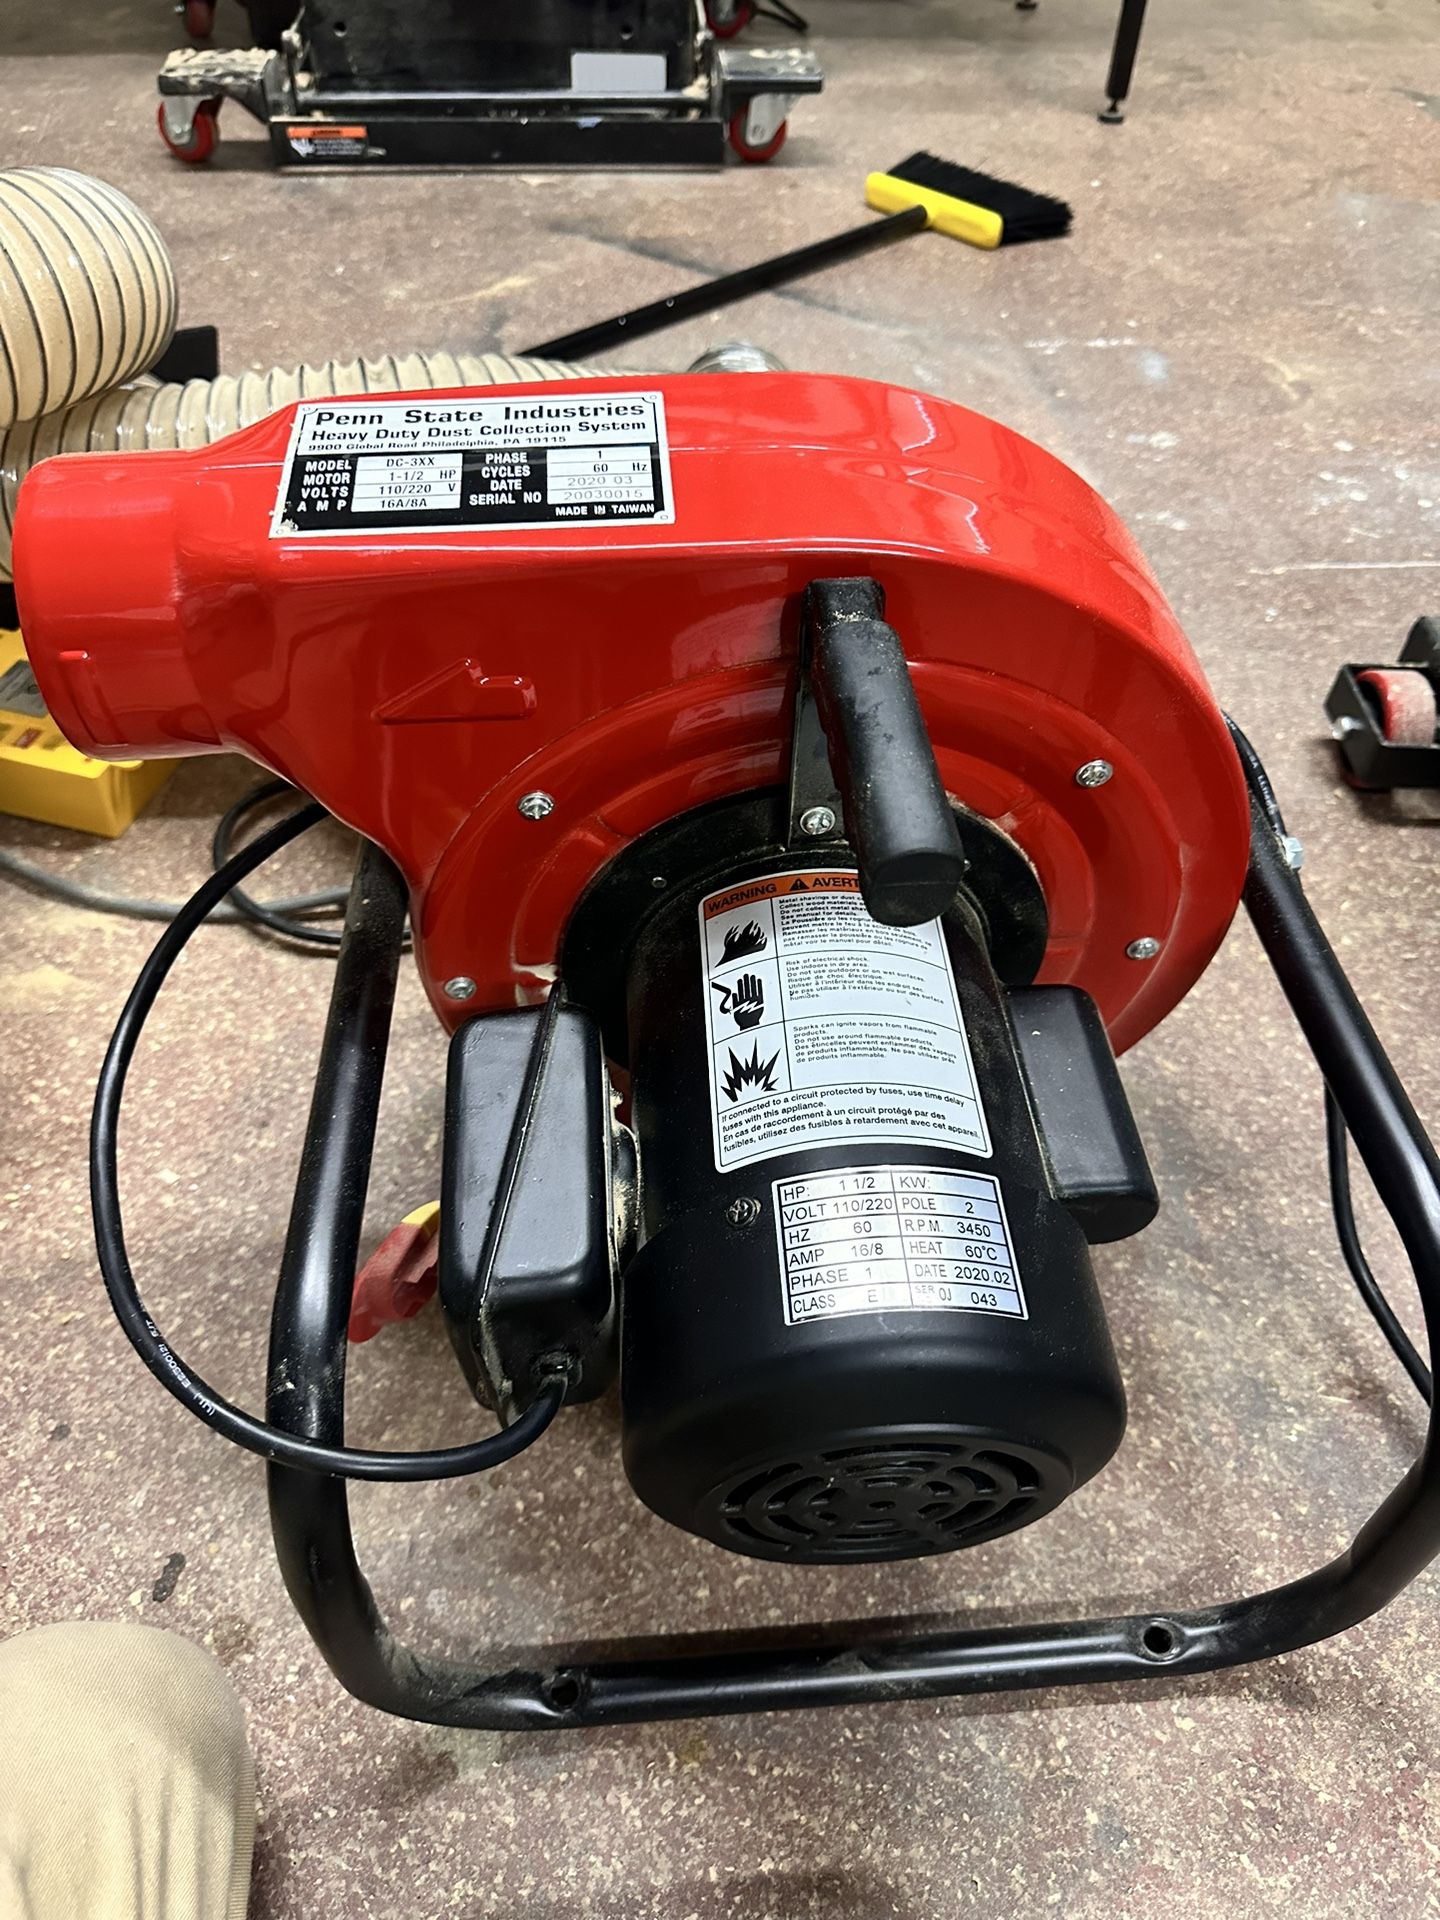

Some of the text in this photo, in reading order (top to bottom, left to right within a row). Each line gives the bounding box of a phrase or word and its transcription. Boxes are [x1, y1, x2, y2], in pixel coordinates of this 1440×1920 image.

[316, 402, 644, 426] Penn State Industries
[312, 421, 646, 442] Heavy Duty Dust Collection System
[346, 442, 384, 450] Global
[388, 441, 417, 449] Road
[422, 439, 498, 448] Philadelphia,
[525, 436, 566, 444] 19115
[305, 457, 435, 472] MODEL DC-3XX
[485, 450, 602, 465] PHASE 1
[303, 470, 456, 486] MOTOR 1-1/2 HP
[481, 462, 648, 478] CYCLES 60 Hz
[301, 482, 456, 500] VOLTS 110/220 V
[490, 475, 633, 491] DATE 2020 03
[380, 498, 427, 509] 16A/8A
[469, 489, 643, 506] SERIAL NO 20030015
[555, 503, 655, 516] MADE IN TAIWAN
[708, 878, 860, 913] WARNING AVERT
[793, 1024, 818, 1032] Sparks
[904, 1024, 937, 1035] flammable
[721, 1114, 727, 1122] If
[728, 1100, 770, 1121] connected
[773, 1098, 782, 1106] to
[791, 1090, 818, 1101] circuit
[820, 1087, 864, 1098] protected
[865, 1087, 877, 1095] by
[879, 1087, 906, 1096] fuses,
[924, 1091, 942, 1101] time
[944, 1095, 965, 1108] delay
[722, 1101, 826, 1133] fuses with this appliance.
[723, 1134, 733, 1143] En
[735, 1129, 749, 1138] cas
[750, 1124, 761, 1133] de
[763, 1110, 824, 1129] raccordement
[826, 1109, 832, 1117] à
[848, 1106, 876, 1115] circuit
[878, 1106, 912, 1116] protégé
[915, 1109, 929, 1117] par
[930, 1111, 946, 1120] des
[724, 1138, 756, 1153] fusibles,
[758, 1128, 787, 1141] utilisez
[790, 1124, 806, 1133] des
[808, 1118, 843, 1129] fusibles
[845, 1116, 852, 1125] à
[853, 1117, 908, 1125] retardement
[911, 1120, 931, 1128] avec
[932, 1122, 946, 1130] cet
[784, 1176, 875, 1201] HP: 1 1/2
[900, 1176, 931, 1190] KW:
[783, 1198, 893, 1223] VOLT 110/220
[902, 1197, 974, 1214] POLE 2
[789, 1221, 872, 1244] HZ 60
[905, 1219, 991, 1237] R.P.M. 3450
[789, 1242, 884, 1267] AMP 16/8
[909, 1241, 998, 1261] HEAT 60°C
[790, 1267, 872, 1290] PHASE 1
[914, 1264, 1011, 1285] DATE 2020.02
[793, 1294, 836, 1314] CLASS
[971, 1291, 998, 1307] 043
